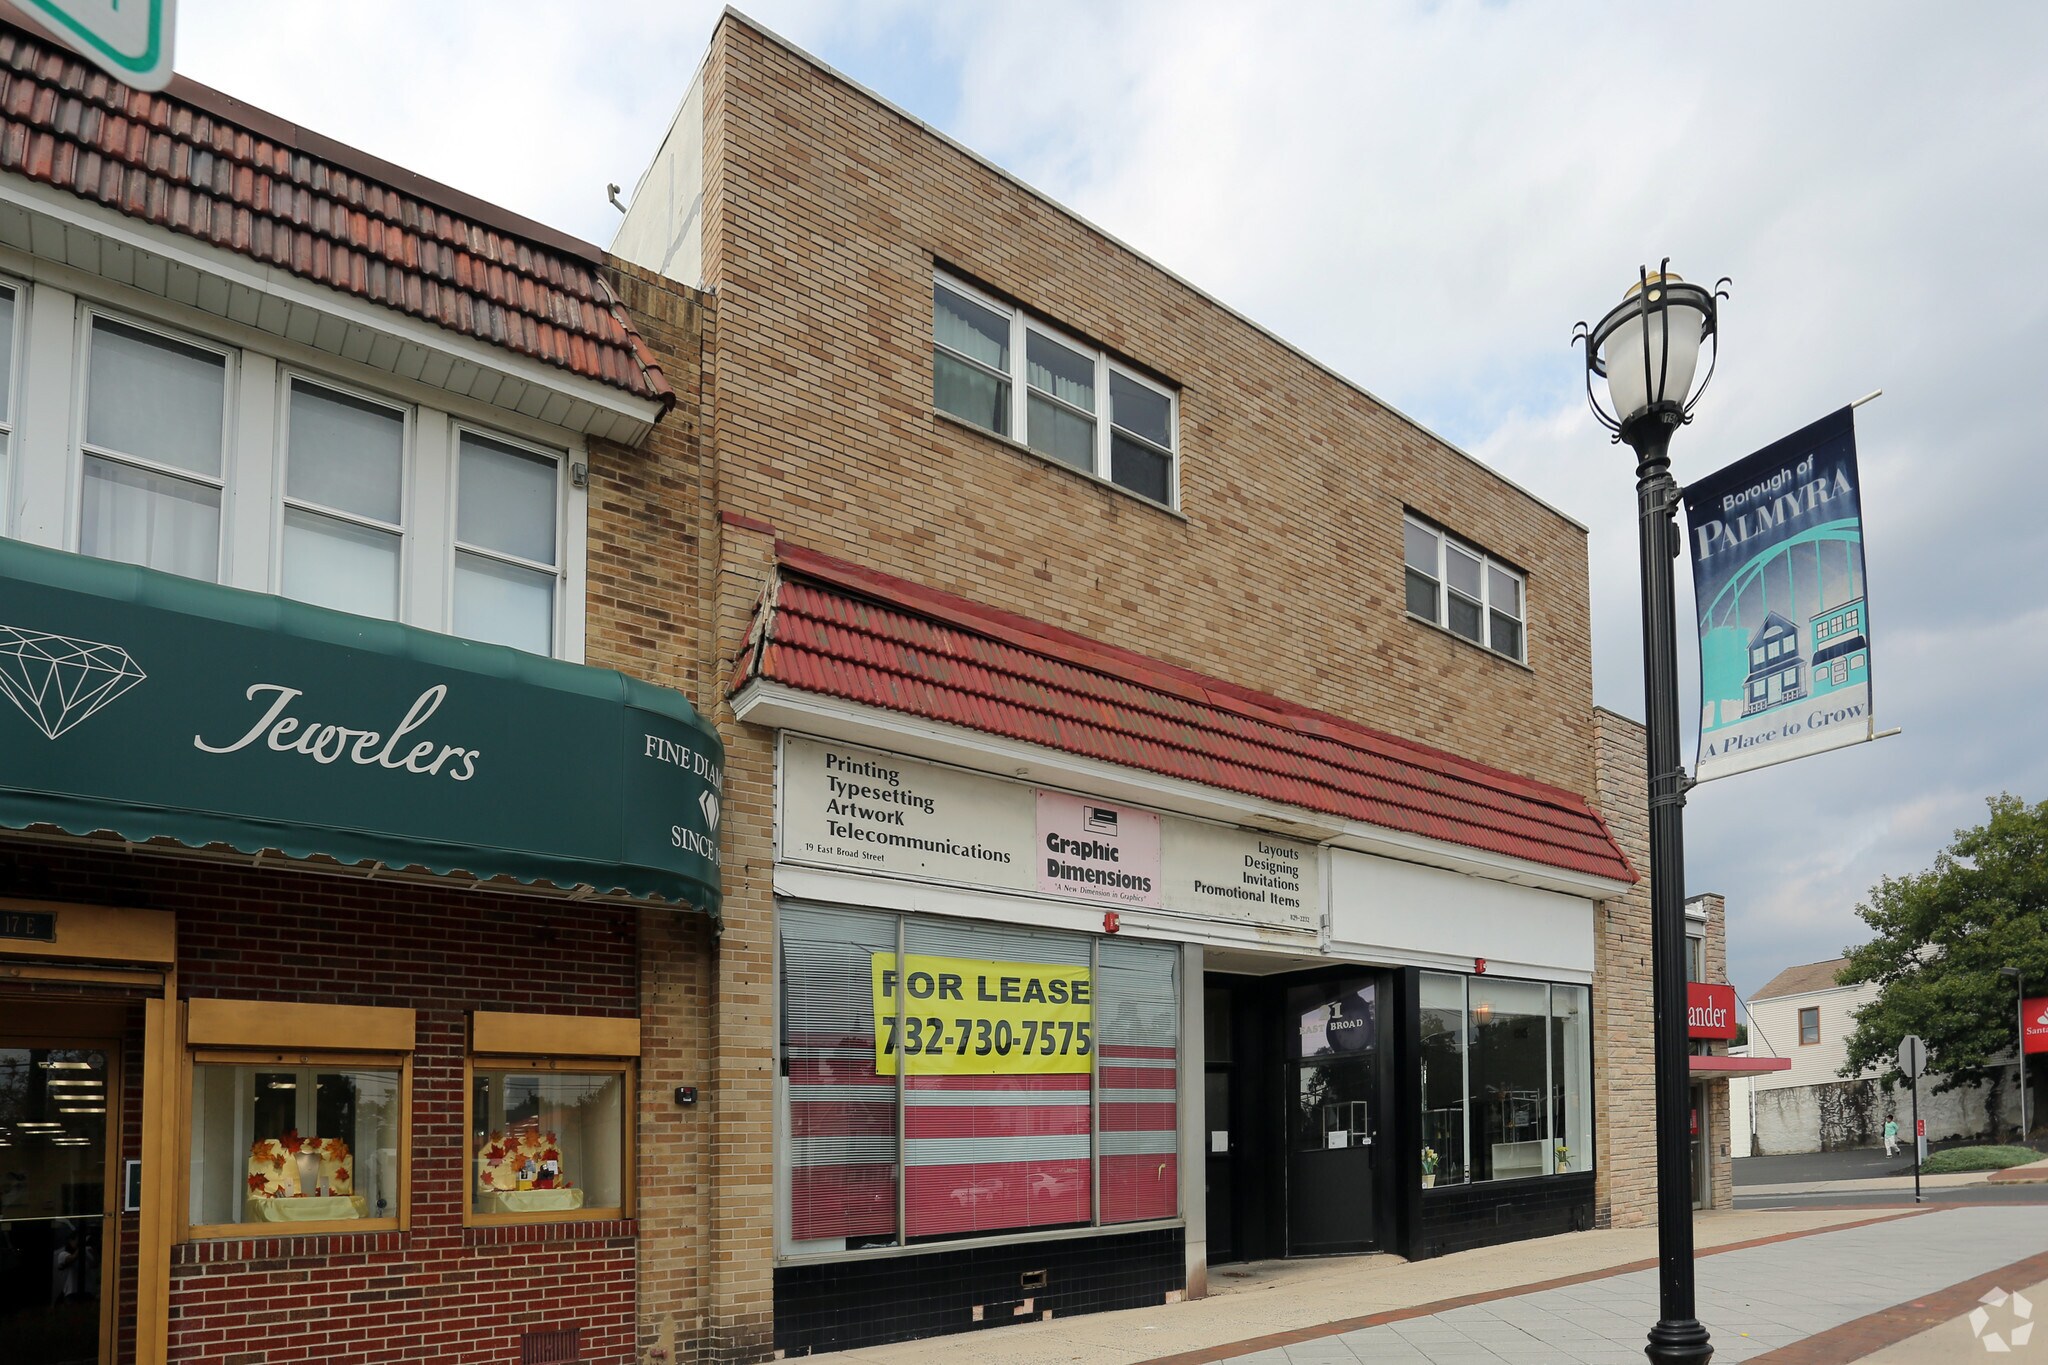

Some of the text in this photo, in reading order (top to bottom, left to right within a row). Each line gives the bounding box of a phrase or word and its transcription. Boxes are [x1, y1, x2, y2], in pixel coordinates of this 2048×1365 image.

[1723, 454, 1814, 512] Borough of
[1694, 468, 1852, 562] PALMYRA
[194, 684, 480, 781] Jewelers
[1704, 702, 1865, 759] A Place to Grow
[644, 734, 691, 770] FINE
[826, 753, 900, 786] Printing
[827, 775, 935, 814] Typesetting
[671, 825, 714, 861] SINCE
[805, 842, 885, 862] 19 East Broad Street
[827, 820, 1011, 864] Telecommunications
[1046, 832, 1119, 863] Graphic
[1258, 841, 1299, 861] Layouts
[1047, 858, 1152, 893] Dimensions
[1243, 872, 1299, 892] Invitations
[1244, 855, 1299, 879] Designing
[1064, 884, 1077, 893] New
[1080, 886, 1111, 897] Dimension
[1112, 890, 1118, 898] in
[1194, 880, 1300, 908] Promotional Items
[6, 915, 35, 934] 17 E
[882, 969, 1090, 1005] FOR LEASE
[882, 1016, 1091, 1056] 732-730-7575
[1299, 1018, 1363, 1036] EAST BROAD
